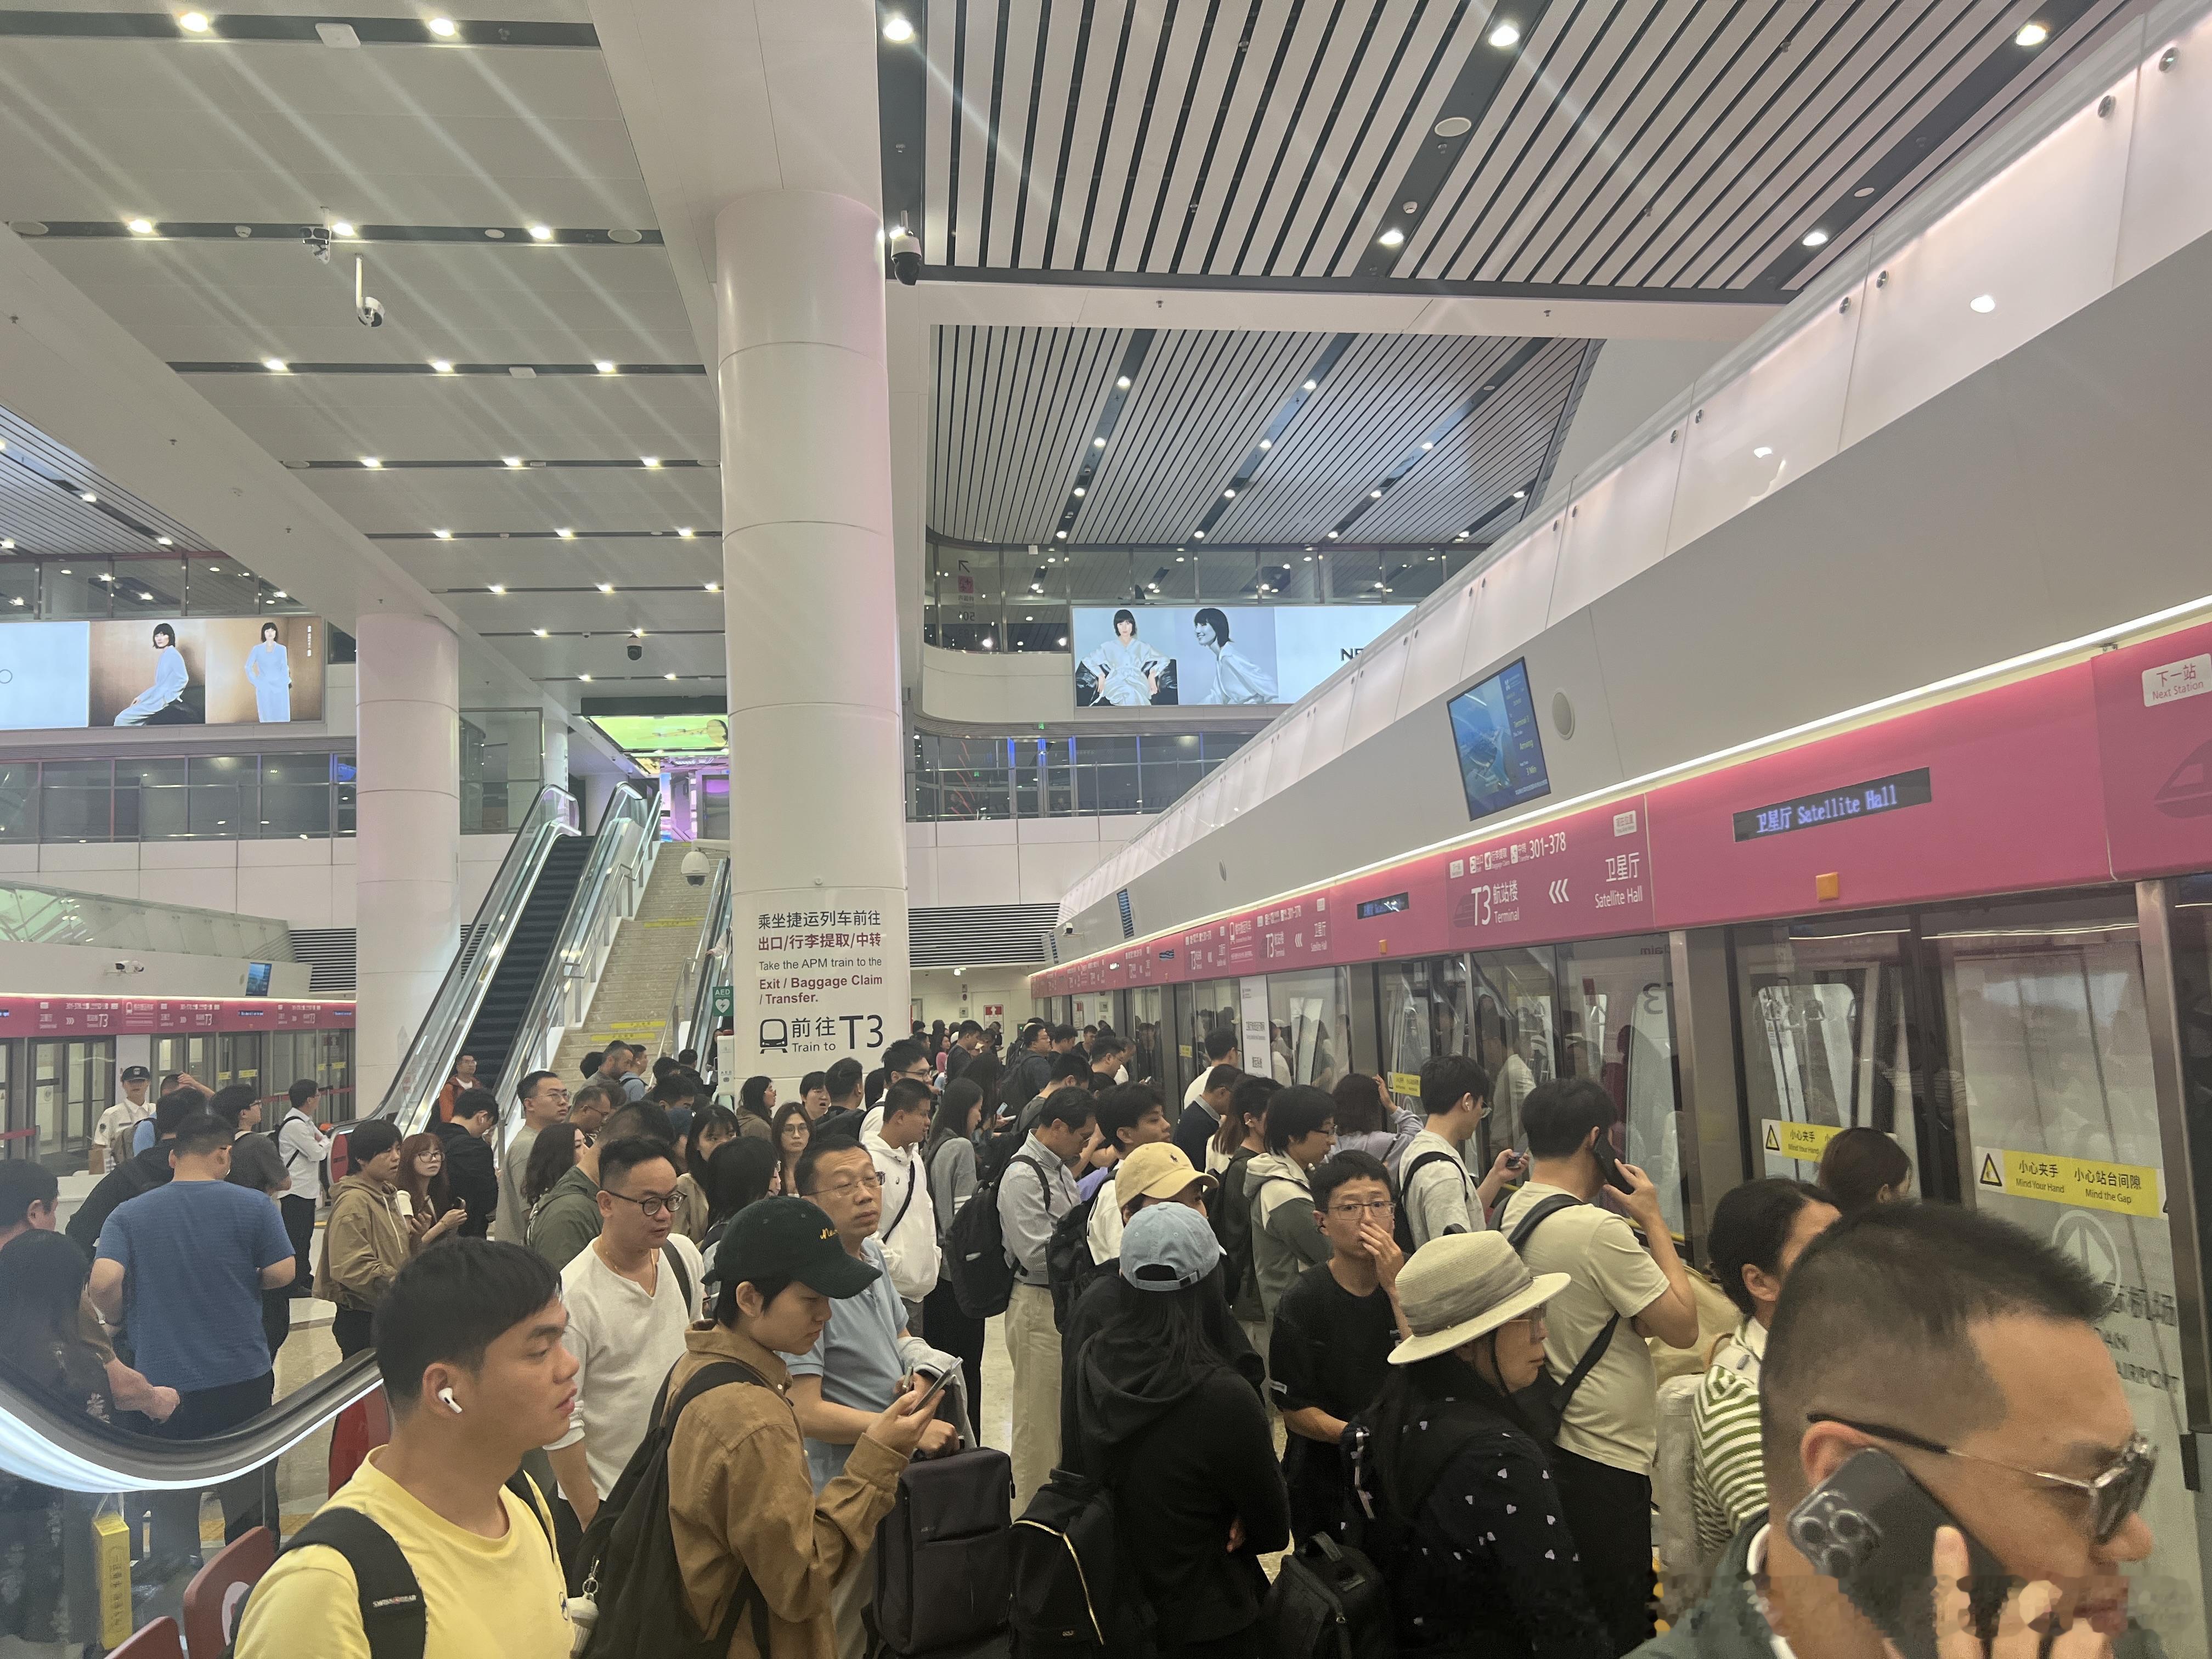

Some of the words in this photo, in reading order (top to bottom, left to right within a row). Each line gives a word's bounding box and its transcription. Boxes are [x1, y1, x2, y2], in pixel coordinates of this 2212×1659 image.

[2156, 663, 2196, 687] 下一站
[2152, 689, 2171, 701] Next
[2174, 681, 2204, 695] Station
[1797, 795, 1860, 825] Satellite
[1865, 785, 1897, 811] Hall
[1757, 806, 1792, 833] 卫星厅
[1529, 831, 1566, 860] 301-378
[1605, 851, 1640, 883] 卫星厅
[1493, 879, 1518, 905] 航站楼
[1595, 889, 1625, 909] Satellite
[1627, 885, 1643, 904] Hall
[1471, 884, 1491, 926] T3
[1494, 907, 1520, 924] Terminal
[758, 910, 881, 929] 乘坐捷运列车前往
[758, 932, 881, 951] 出口/行李提取/中转
[759, 961, 780, 970] Take
[783, 960, 799, 969] the
[802, 958, 827, 968] APM
[831, 958, 854, 968] train
[857, 958, 866, 967] to
[868, 957, 882, 966] the
[760, 979, 780, 990] Exit
[791, 977, 847, 989] Baggage
[851, 975, 882, 985] Claim
[765, 992, 819, 1005] Transfer.
[791, 1017, 836, 1039] 前往
[839, 1014, 883, 1049] T3
[792, 1042, 820, 1053] Train
[824, 1042, 836, 1051] to
[1790, 1129, 1815, 1143] 小心夹手
[2016, 1178, 2031, 1188] Mind
[2032, 1181, 2046, 1190] Your
[2047, 1183, 2064, 1193] Hand
[2019, 1160, 2058, 1178] 小心夹手
[2074, 1167, 2141, 1190] 小心站台间隙
[2085, 1188, 2102, 1199] Mind
[2104, 1192, 2116, 1201] the
[2117, 1193, 2131, 1205] Gap
